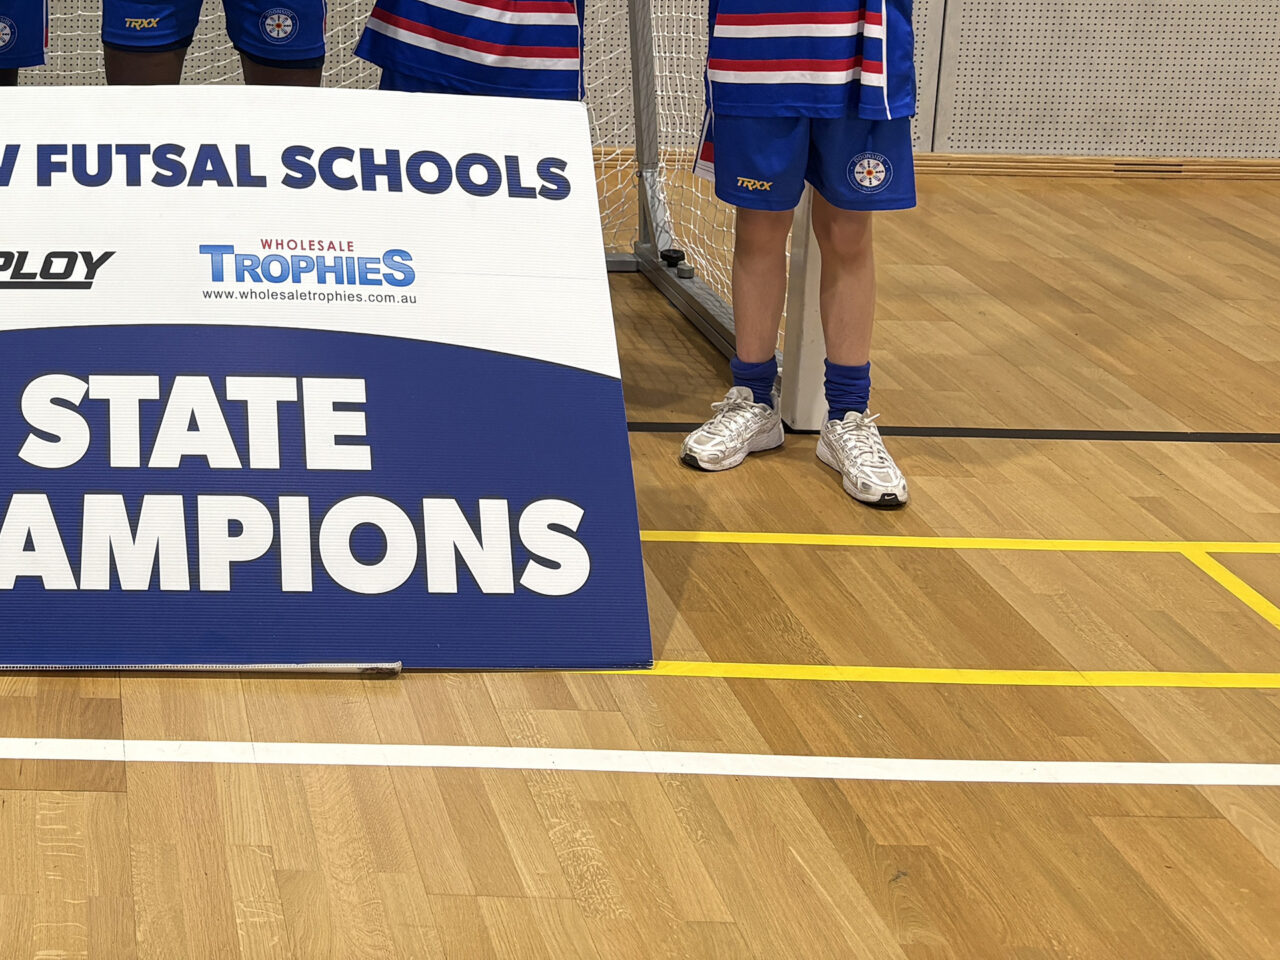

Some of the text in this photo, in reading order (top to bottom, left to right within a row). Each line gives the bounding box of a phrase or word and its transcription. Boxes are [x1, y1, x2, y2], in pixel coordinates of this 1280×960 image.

[125, 18, 160, 31] TRXX
[36, 143, 267, 188] FUTSAL
[280, 145, 571, 201] SCHOOLS
[736, 176, 774, 191] TRXX
[260, 238, 354, 252] WHOLESALE
[202, 289, 417, 304] www.wholesaletrophies.com.au
[18, 374, 372, 471] STATE
